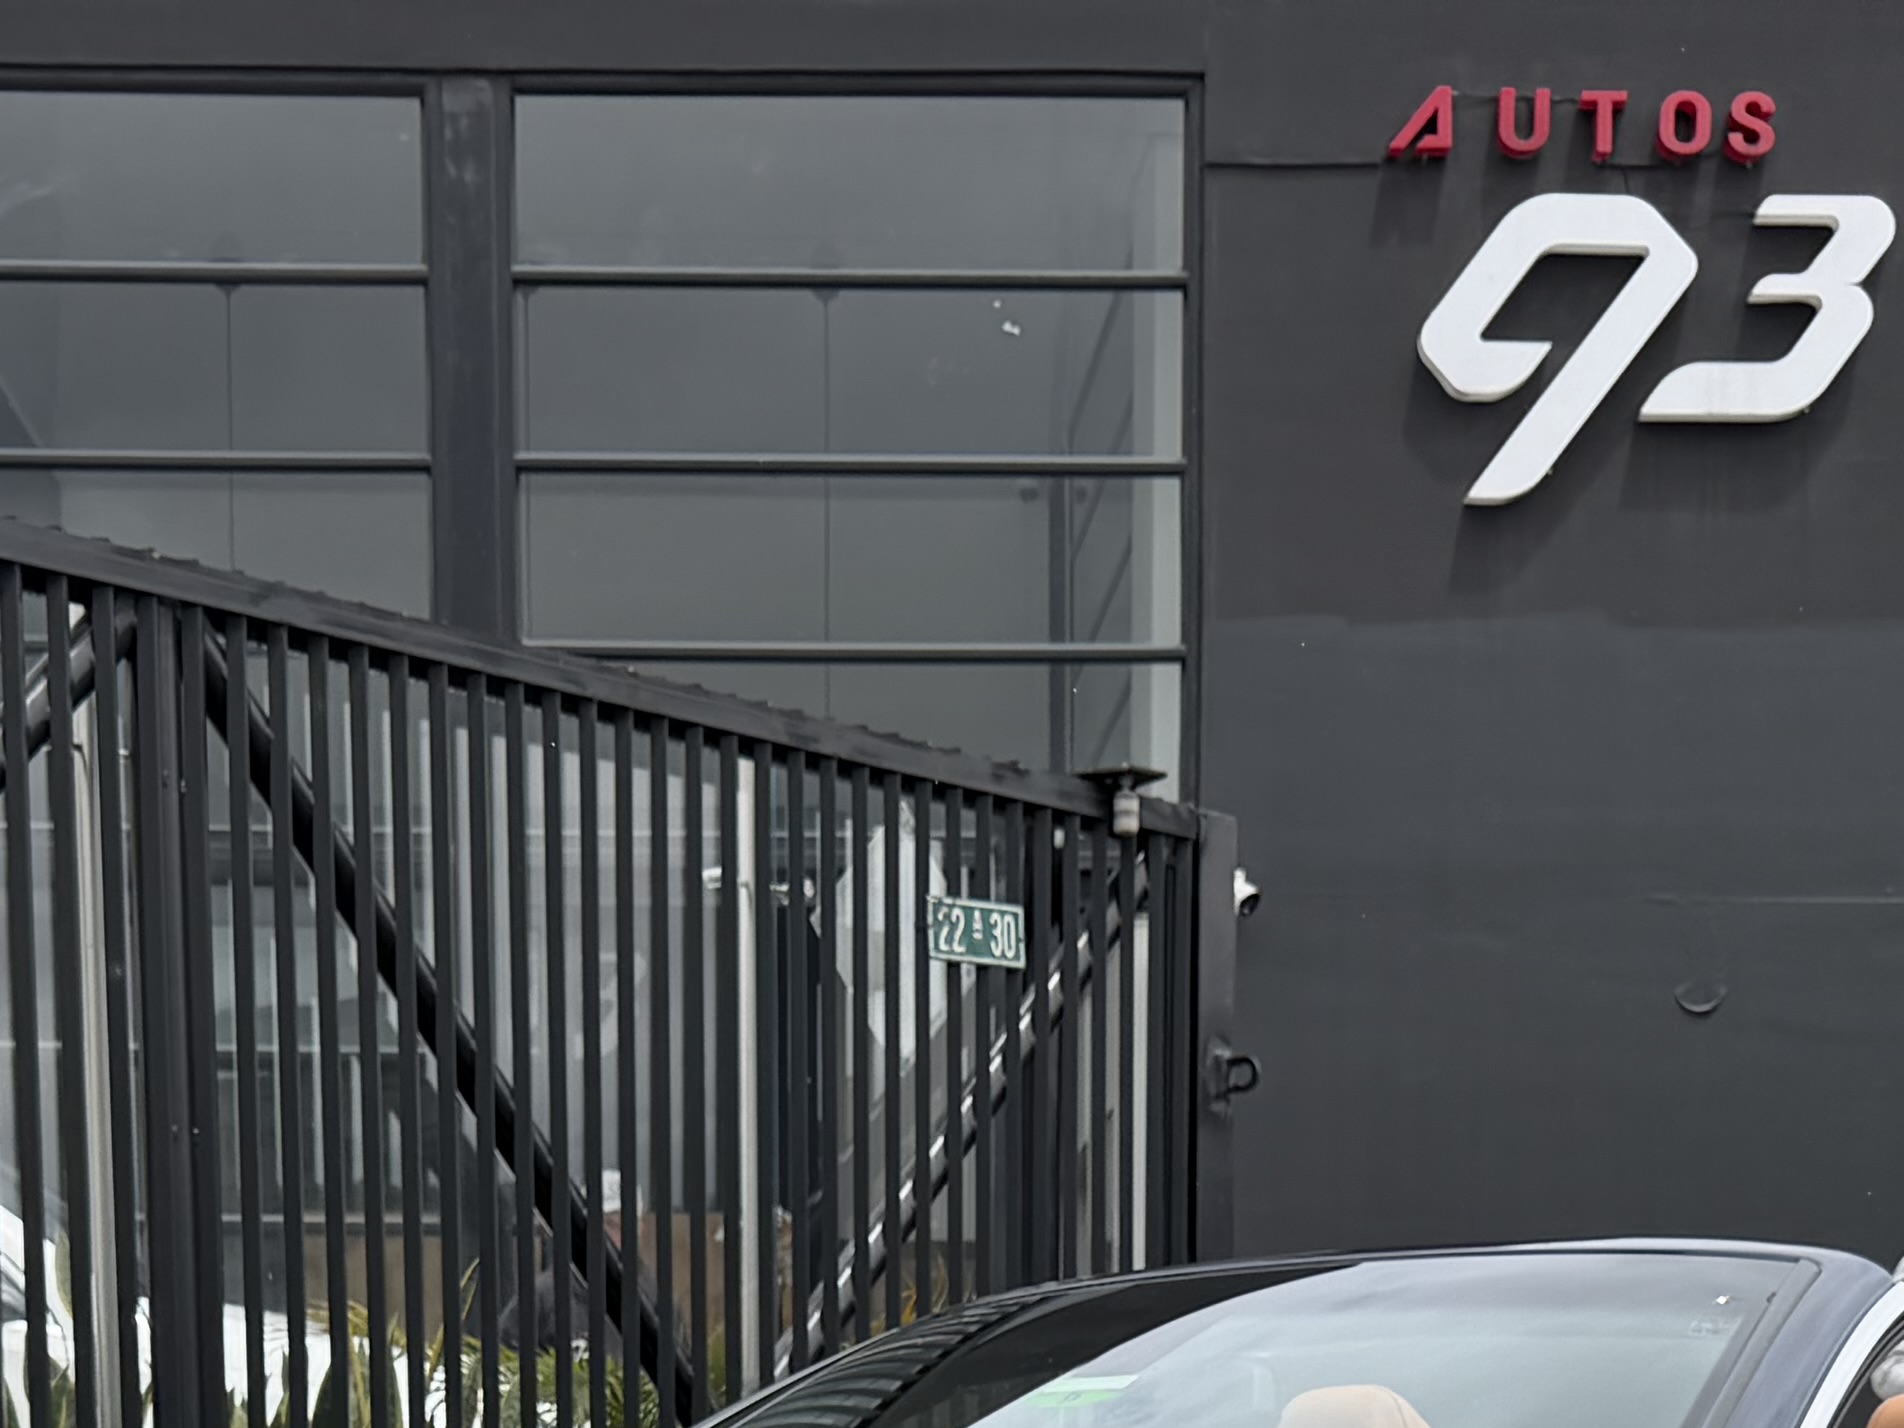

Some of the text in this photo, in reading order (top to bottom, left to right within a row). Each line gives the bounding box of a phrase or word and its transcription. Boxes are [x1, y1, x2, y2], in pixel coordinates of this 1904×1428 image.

[1387, 85, 1777, 164] AUTOS
[1416, 192, 1896, 505] 93
[937, 905, 966, 953] 22
[989, 912, 1016, 959] 30
